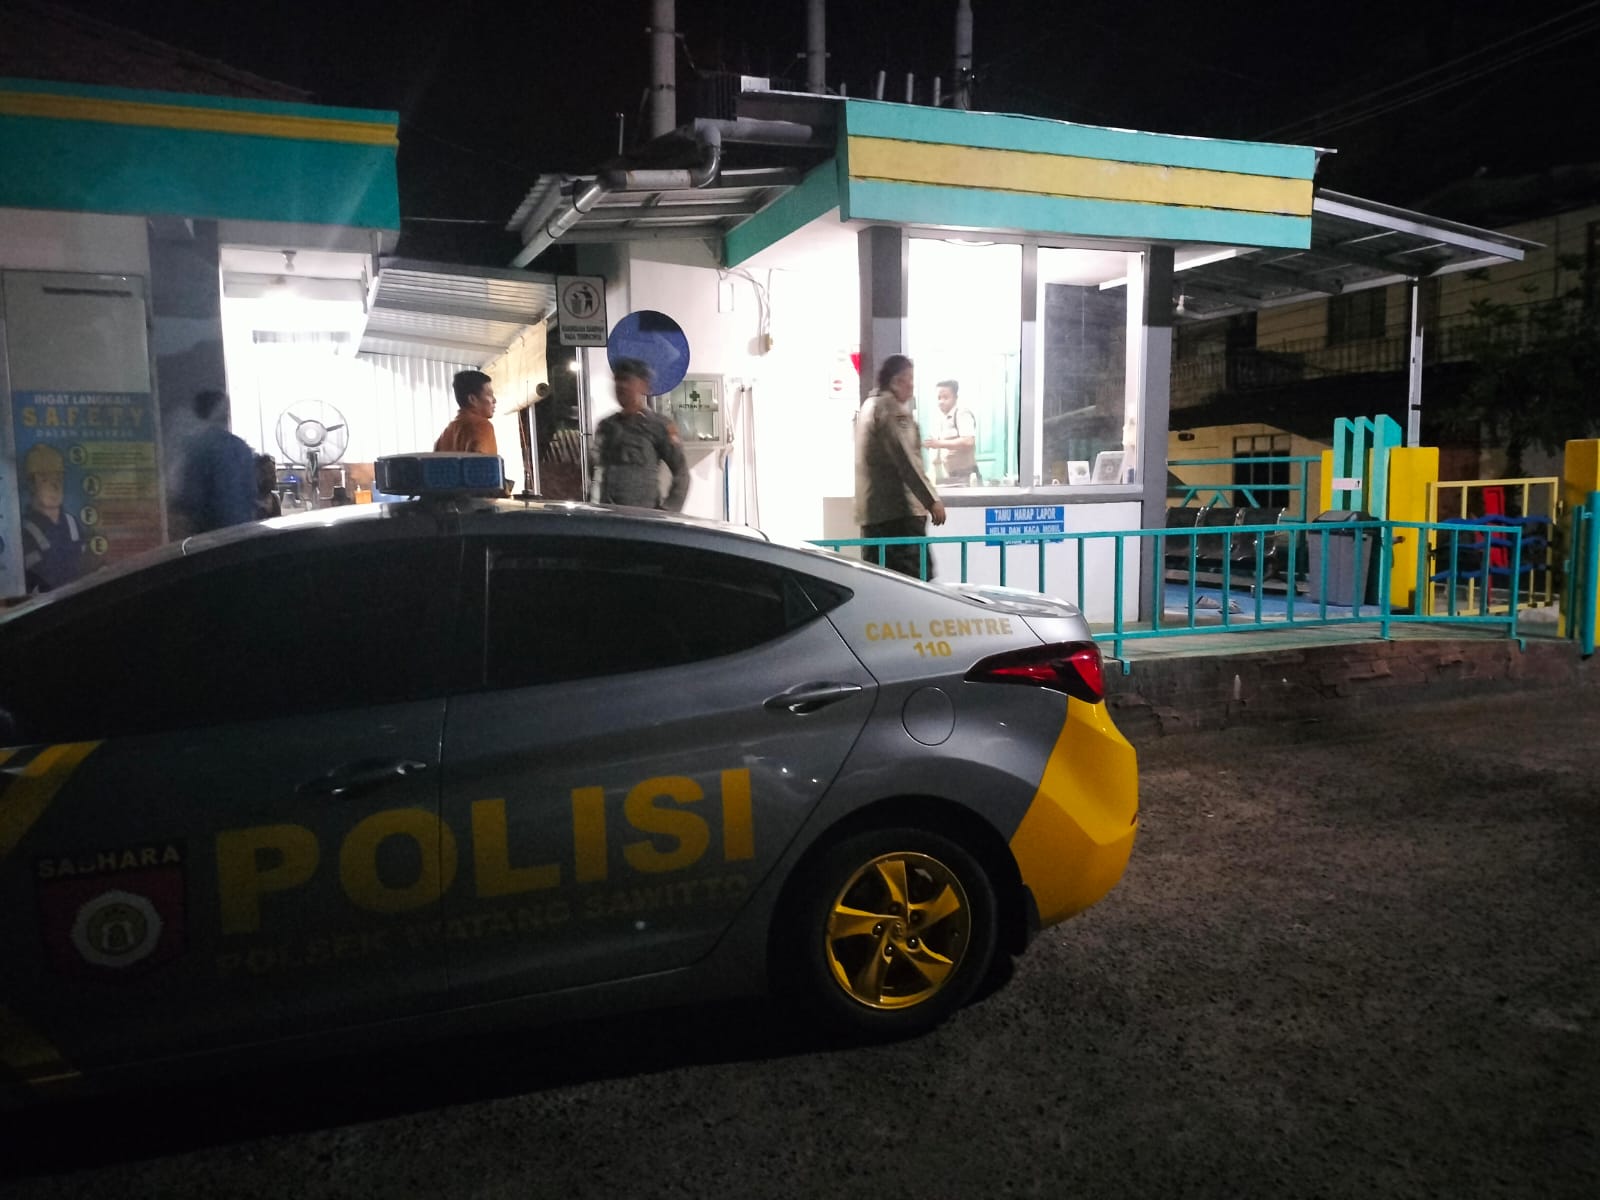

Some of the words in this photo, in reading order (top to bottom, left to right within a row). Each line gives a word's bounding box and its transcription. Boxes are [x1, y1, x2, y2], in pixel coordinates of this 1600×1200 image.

[34, 394, 69, 405] INGAT
[994, 509, 1012, 521] TAMU
[1013, 508, 1034, 521] HARAP
[1036, 507, 1056, 520] LAPOR
[1009, 526, 1021, 535] DAN
[865, 621, 922, 641] CALL
[929, 618, 1013, 638] CENTRE
[914, 640, 953, 657] 110
[214, 767, 757, 935] POLISI
[585, 874, 749, 919] SAWITTO
